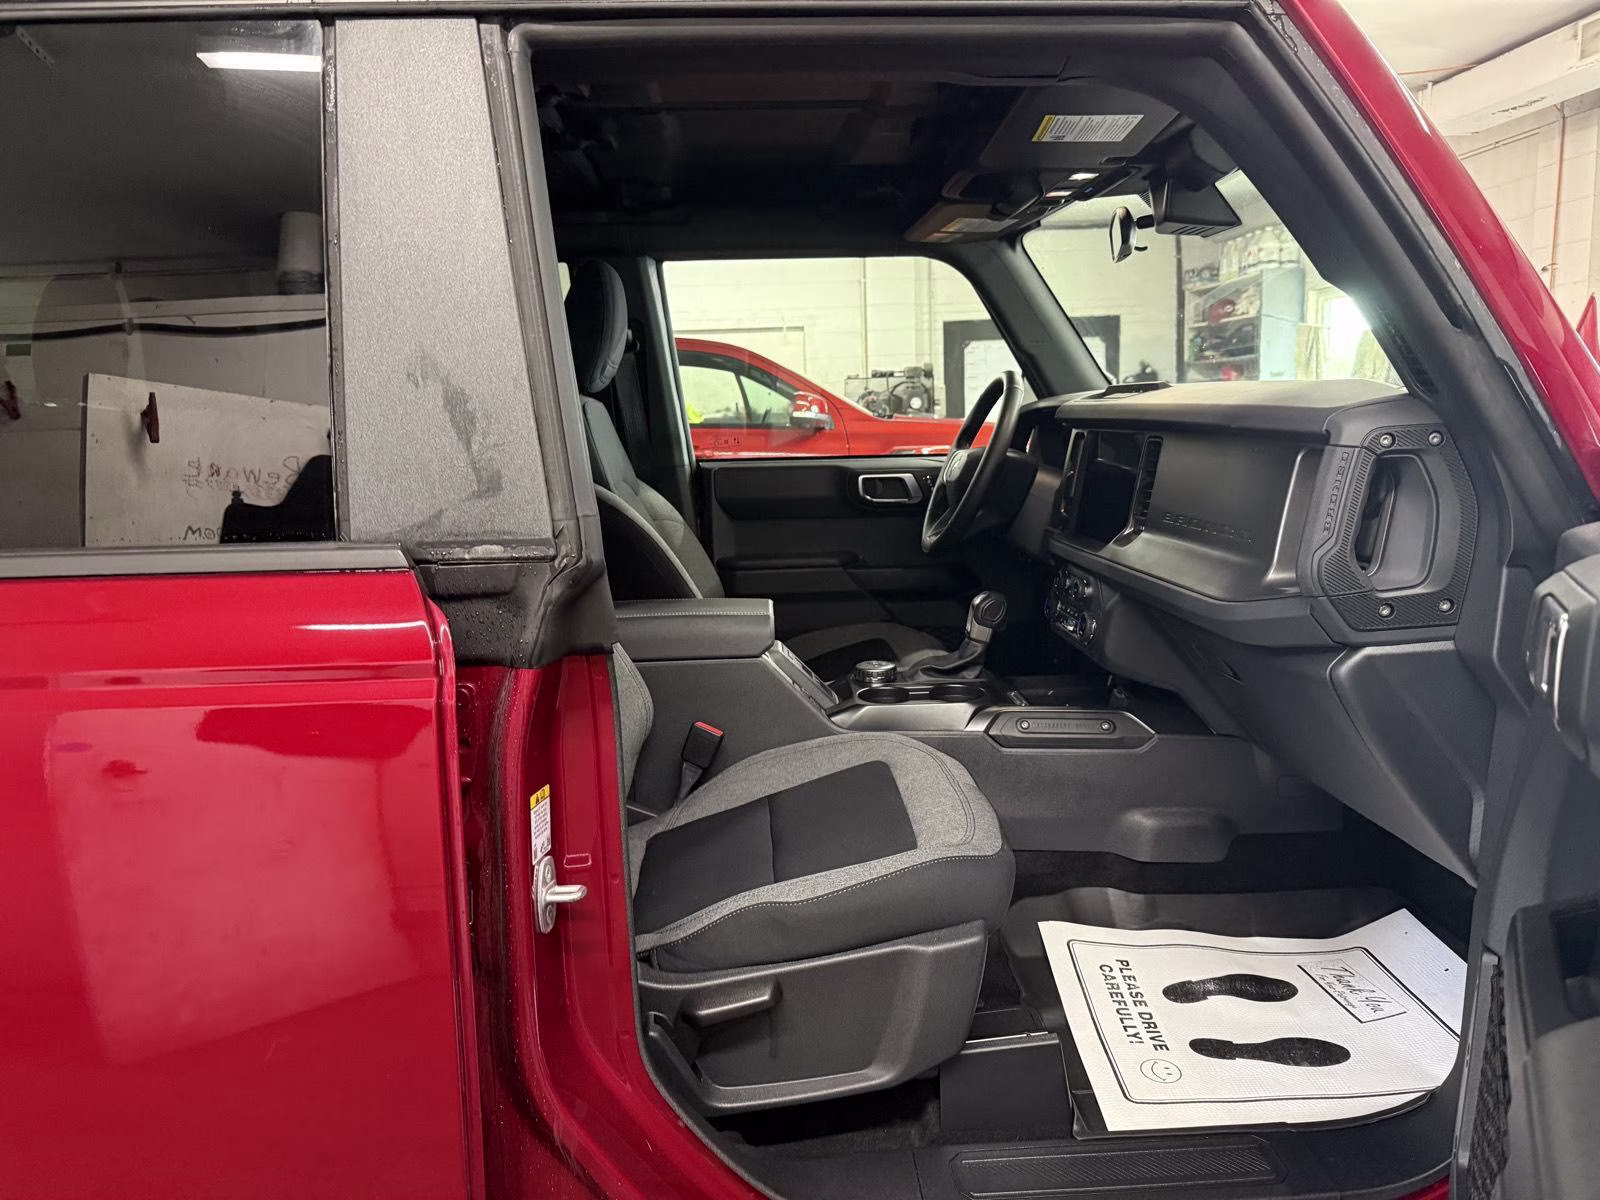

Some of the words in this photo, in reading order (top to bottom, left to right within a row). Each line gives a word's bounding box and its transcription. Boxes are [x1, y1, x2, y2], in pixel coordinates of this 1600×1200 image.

[1099, 964, 1144, 1044] CAREFULLY!
[1115, 959, 1148, 1007] PLEASE
[1138, 1012, 1170, 1051] DRIVE
[1320, 966, 1376, 996] Thank
[1357, 996, 1393, 1013] You
